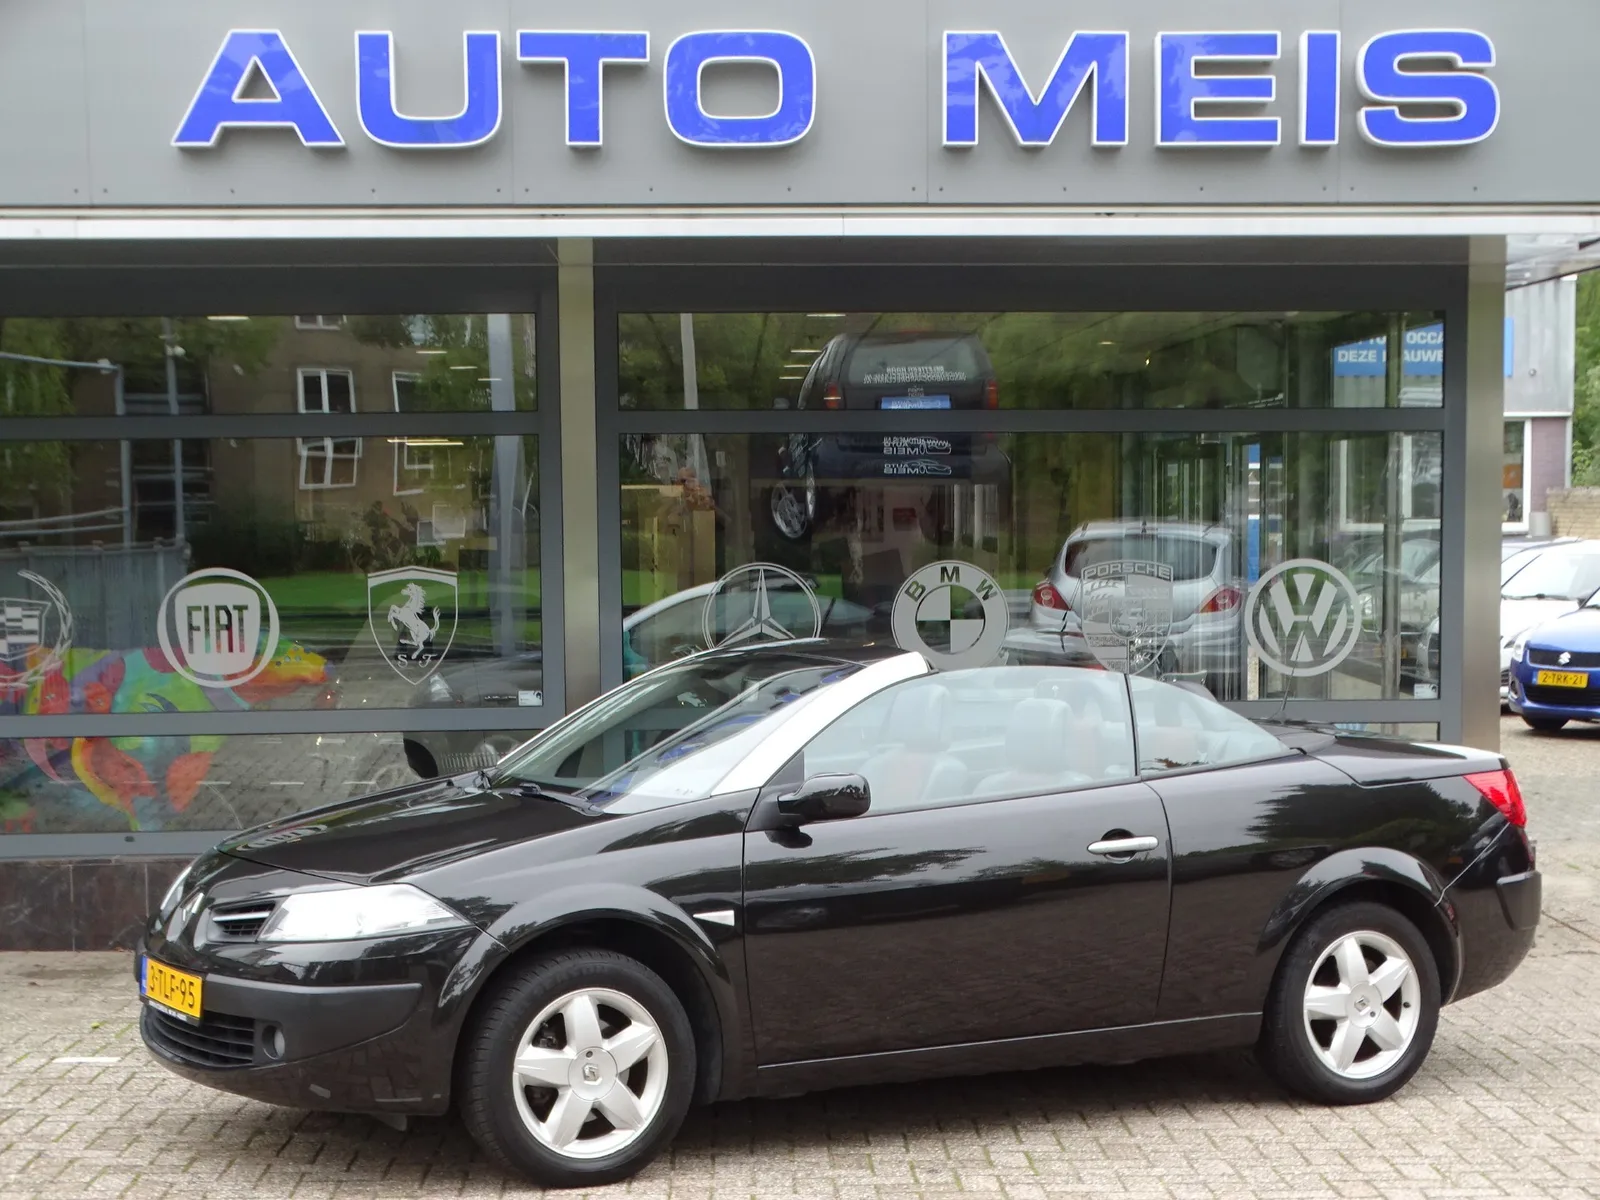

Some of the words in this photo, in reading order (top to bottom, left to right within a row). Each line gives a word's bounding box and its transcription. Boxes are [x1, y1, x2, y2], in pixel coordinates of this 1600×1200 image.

[171, 28, 817, 149] AUTO
[942, 28, 1501, 149] MEIS
[1337, 349, 1377, 362] DEZE
[904, 565, 998, 603] BMW
[1084, 561, 1171, 580] PORSCHE
[185, 604, 249, 655] FIAT
[1541, 672, 1584, 686] 2-TRK-21
[149, 965, 196, 1009] 3-TLF-95
